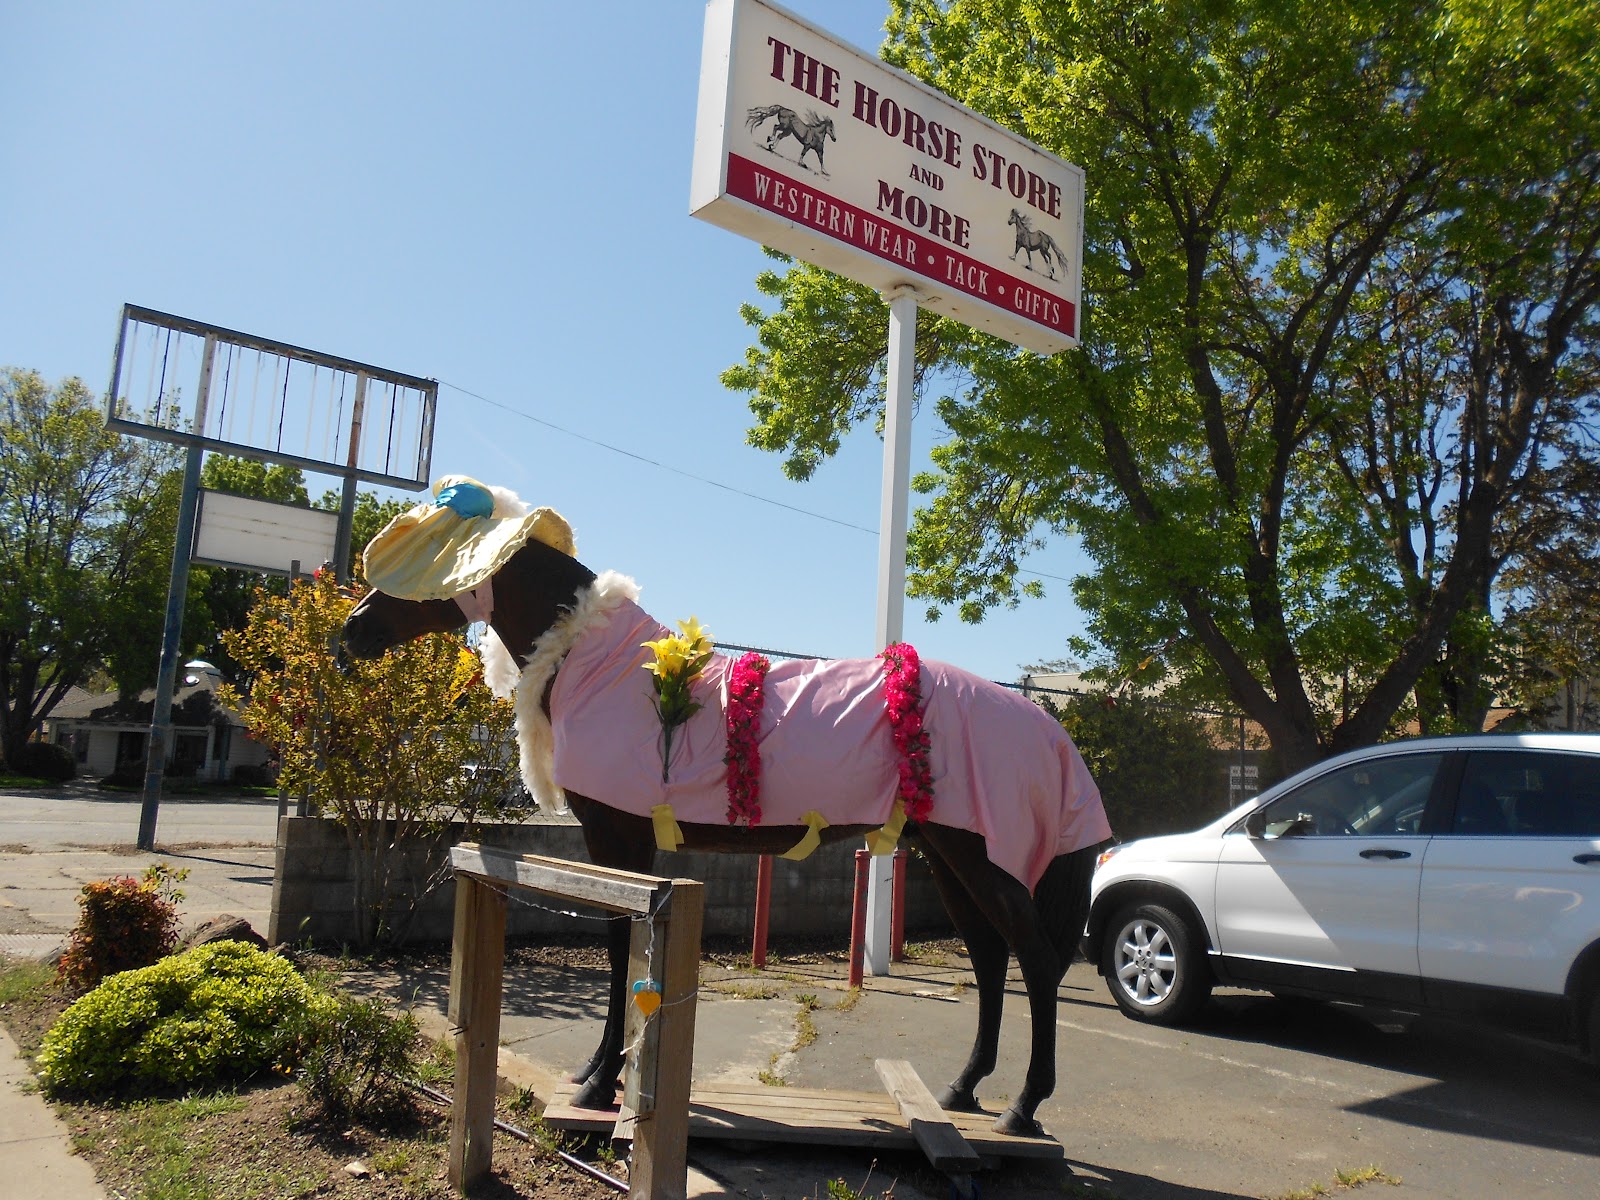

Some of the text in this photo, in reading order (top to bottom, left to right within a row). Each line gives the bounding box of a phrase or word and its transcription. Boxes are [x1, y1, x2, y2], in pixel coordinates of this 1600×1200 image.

[767, 36, 1061, 219] THE HORSE STORE
[909, 163, 944, 191] AND
[754, 171, 1060, 325] WESTERN WEAR TACK GIFTS
[876, 179, 971, 250] MORE
